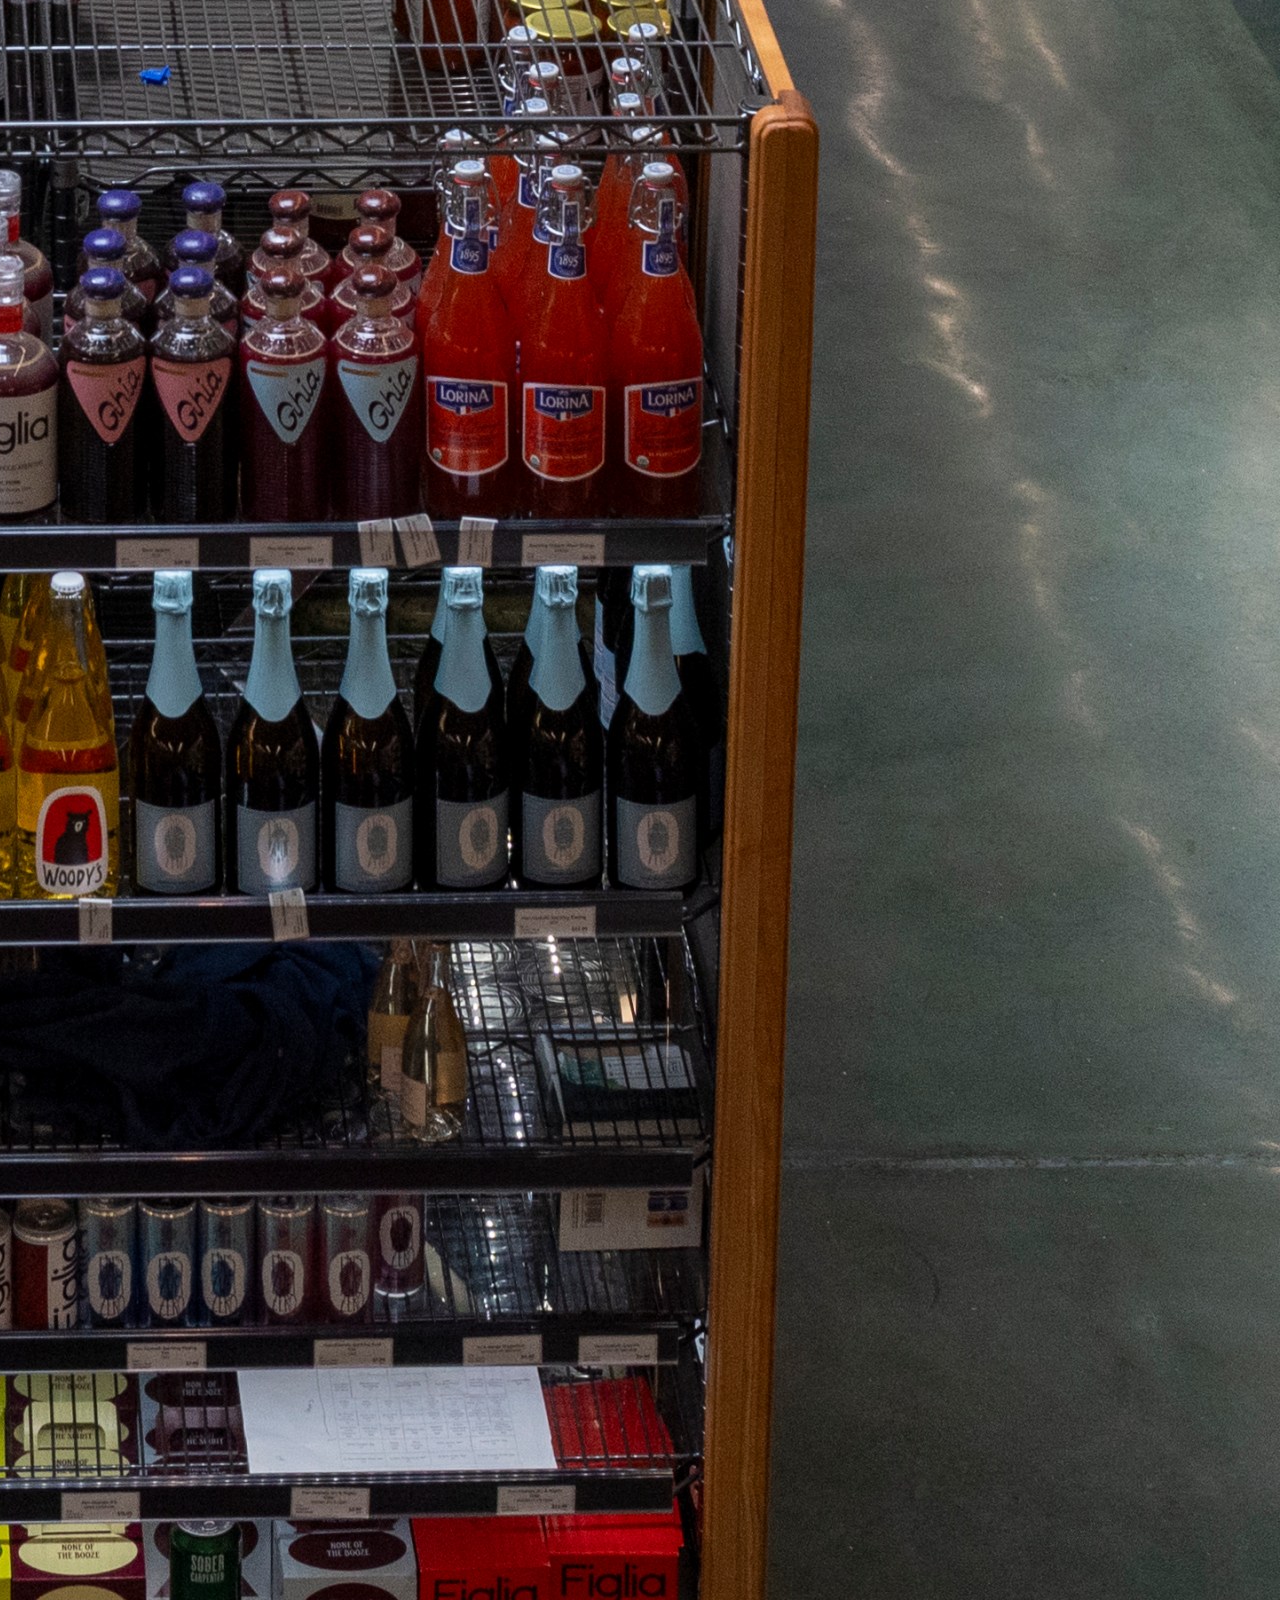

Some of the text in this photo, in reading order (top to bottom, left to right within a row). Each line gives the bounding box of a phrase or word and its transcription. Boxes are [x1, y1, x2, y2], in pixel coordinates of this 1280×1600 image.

[458, 249, 482, 266] 1895
[557, 249, 580, 267] 1895
[653, 248, 675, 267] 1895
[98, 369, 140, 432] Ghia
[176, 368, 223, 431] Ghia
[276, 361, 323, 433] Ghia
[368, 365, 413, 433] Ghia
[439, 387, 490, 407] LORINA
[538, 390, 590, 411] LORINA
[646, 385, 697, 407] LORINA
[42, 862, 105, 888] WOODY'S
[57, 1551, 100, 1560] THE BOOZE
[61, 1543, 94, 1552] NONE OF
[326, 1549, 370, 1558] THE BOOZE
[330, 1541, 362, 1550] NONE OF
[189, 1554, 226, 1572] SOBER
[561, 1562, 668, 1600] Figlia
